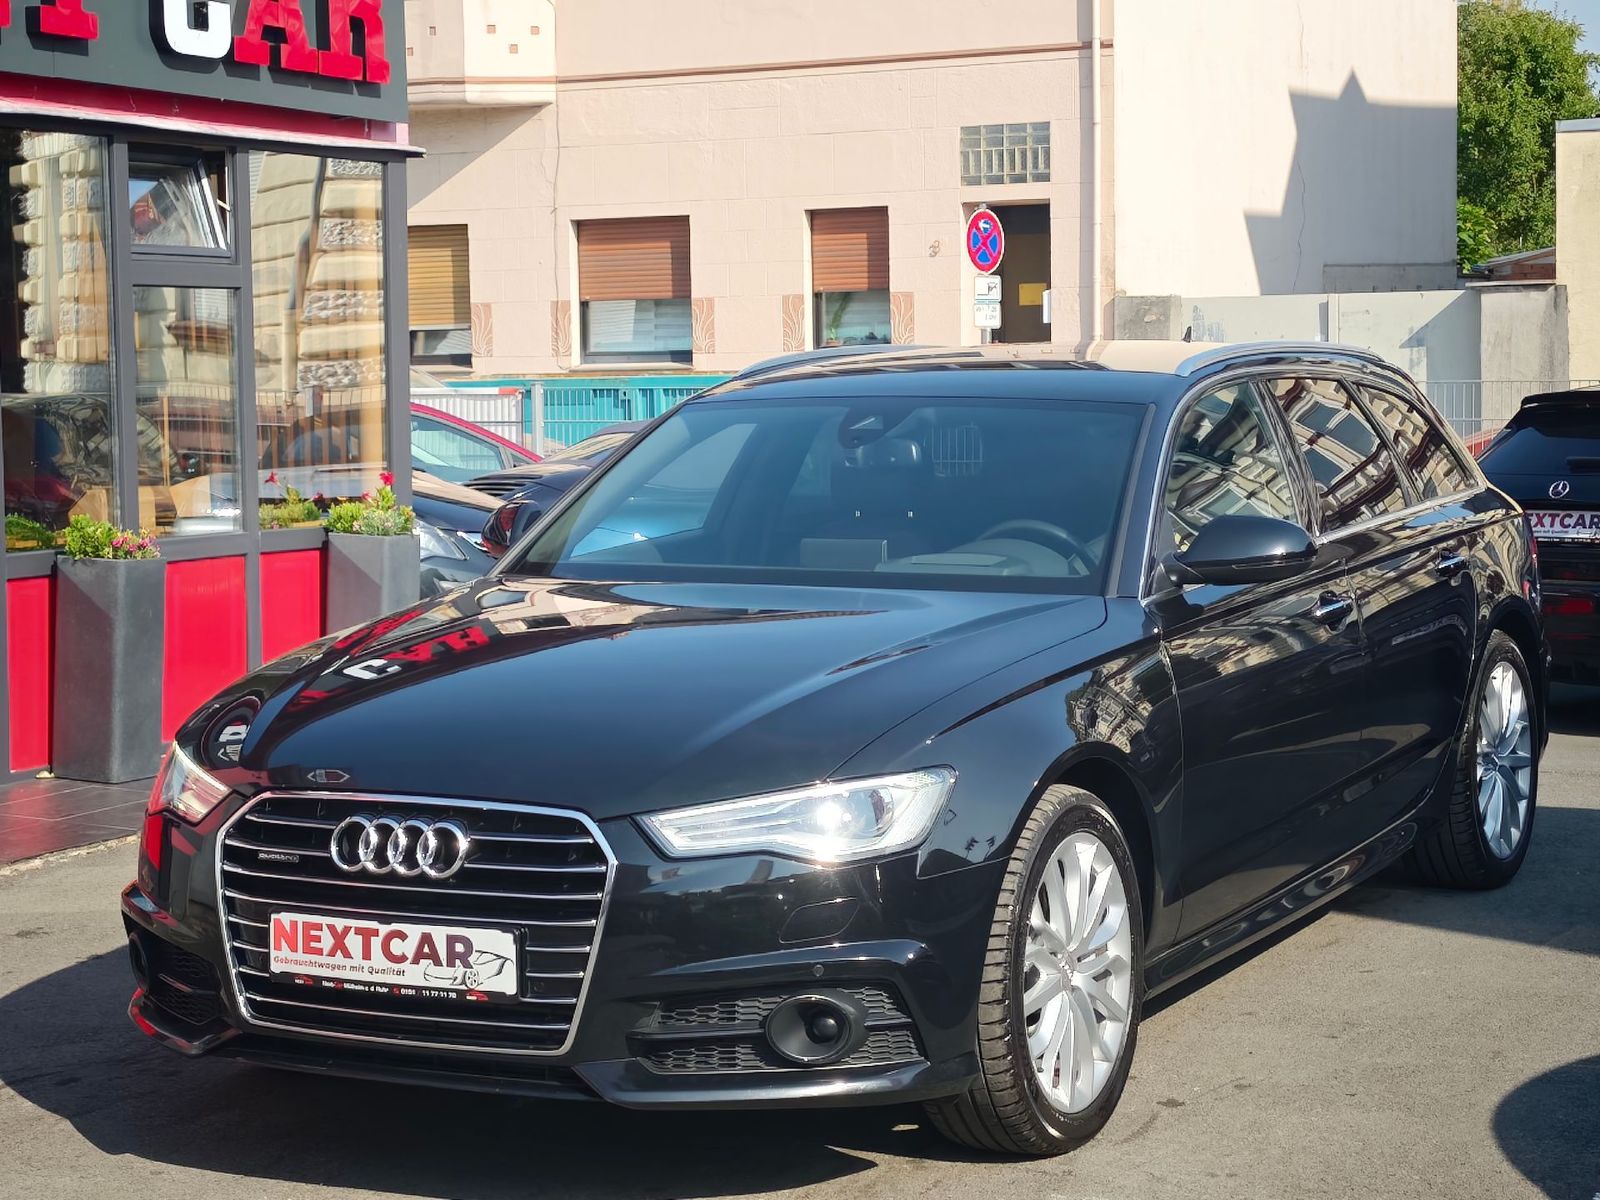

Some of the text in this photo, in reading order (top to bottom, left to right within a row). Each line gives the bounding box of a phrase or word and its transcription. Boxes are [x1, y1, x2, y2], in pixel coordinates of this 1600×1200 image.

[273, 917, 474, 969] NEXTCAR
[273, 955, 406, 977] Gebrauchtwagen mit Qualität
